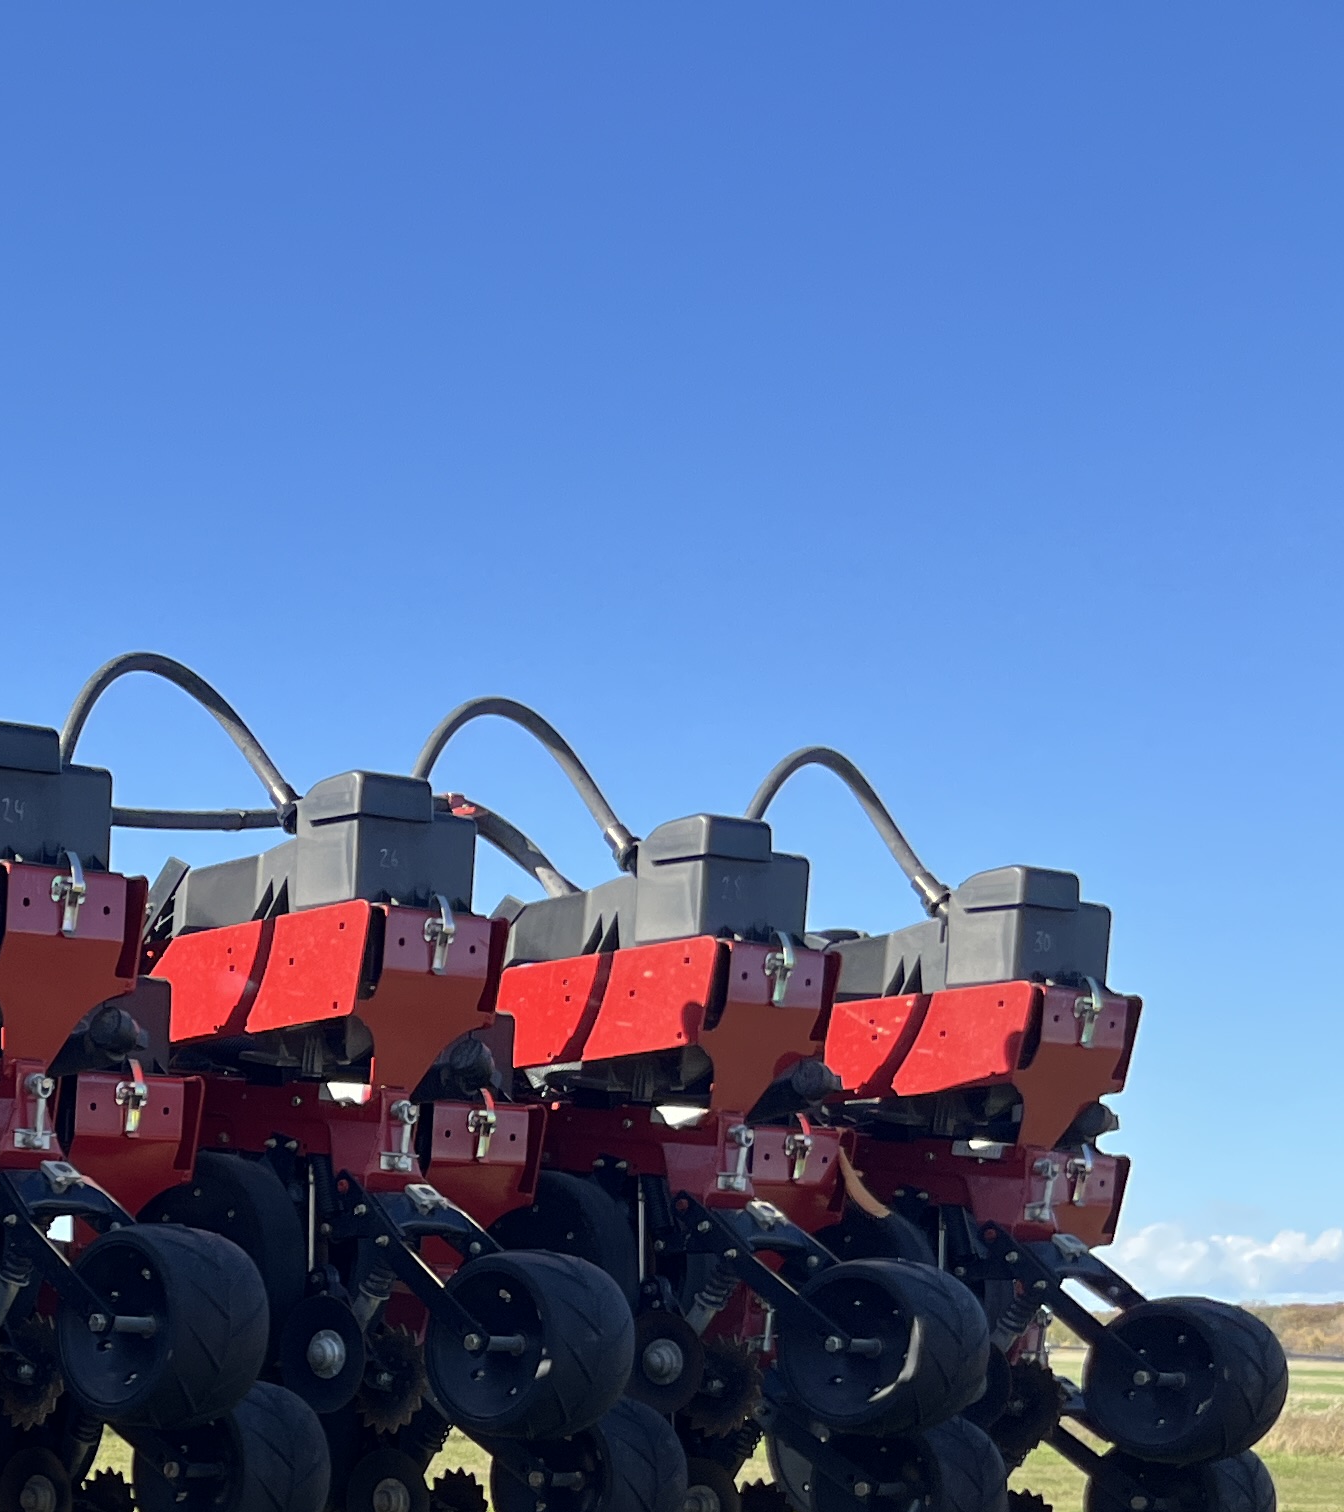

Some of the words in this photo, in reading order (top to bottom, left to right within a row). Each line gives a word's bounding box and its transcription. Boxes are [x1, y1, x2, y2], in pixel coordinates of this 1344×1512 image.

[1, 796, 27, 824] 24
[379, 847, 400, 869] 26
[1033, 929, 1052, 953] 30
